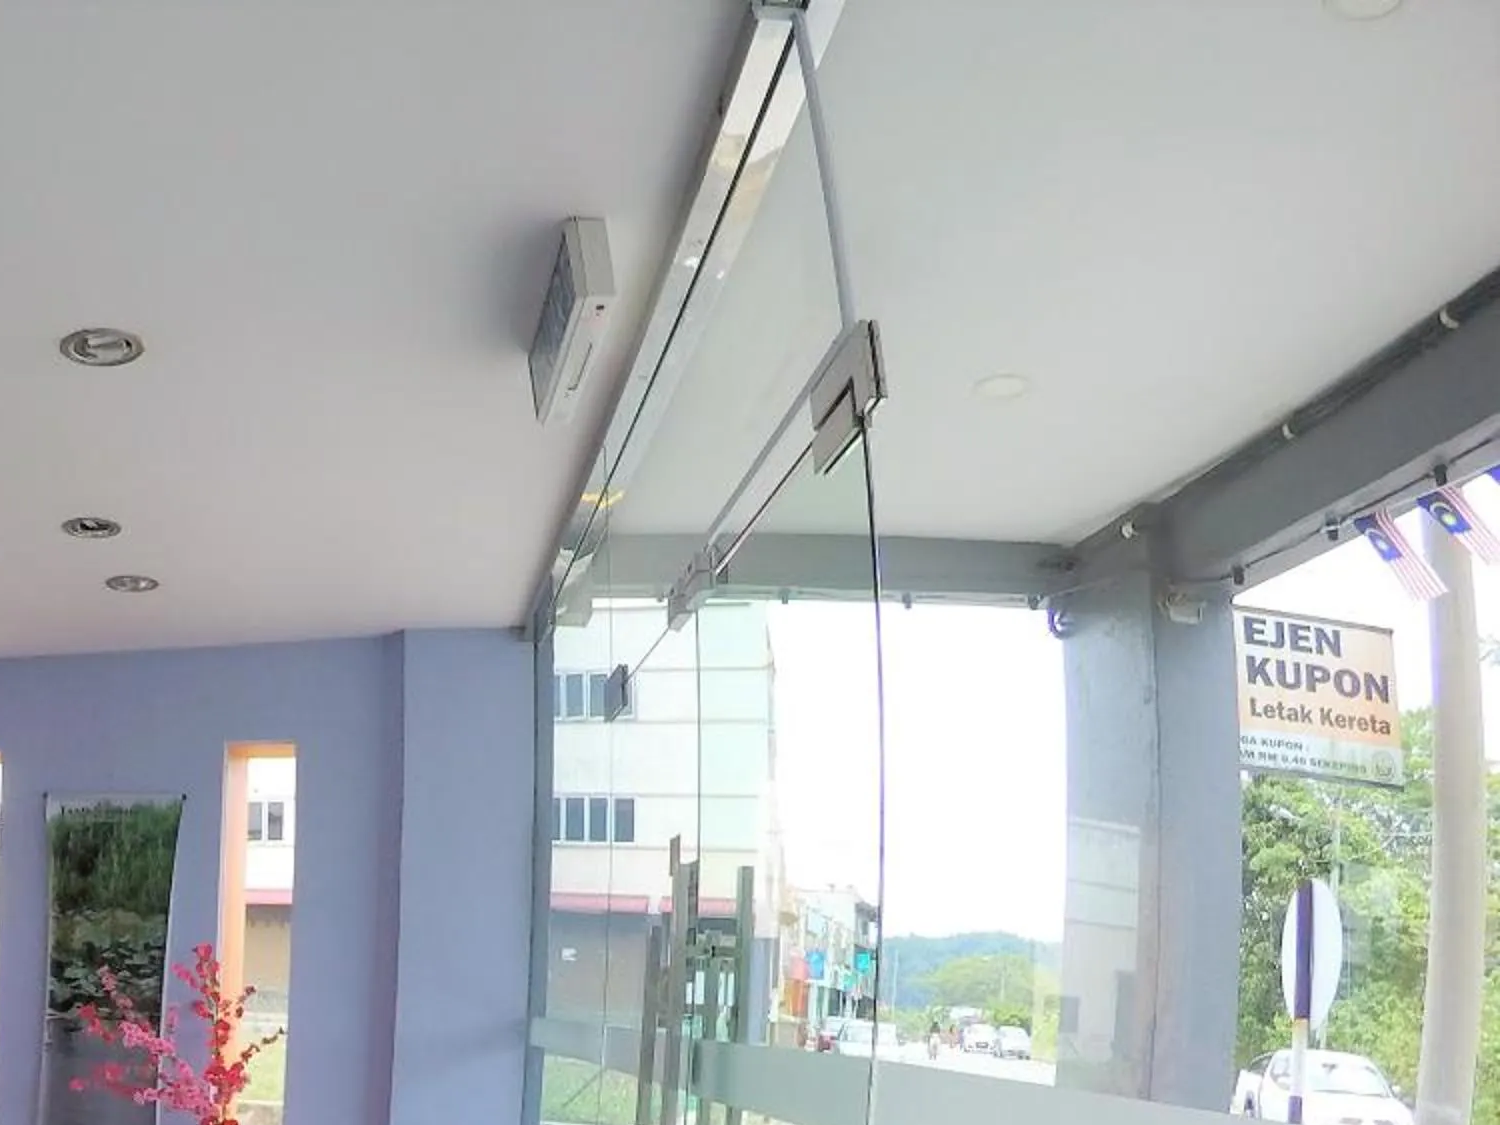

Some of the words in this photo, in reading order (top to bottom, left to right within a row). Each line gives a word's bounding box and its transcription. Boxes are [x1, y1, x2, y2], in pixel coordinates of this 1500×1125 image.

[1243, 615, 1341, 658] EJEN
[1245, 655, 1390, 704] KUPON
[1250, 697, 1313, 725] Letak
[1320, 707, 1391, 736] Kereta
